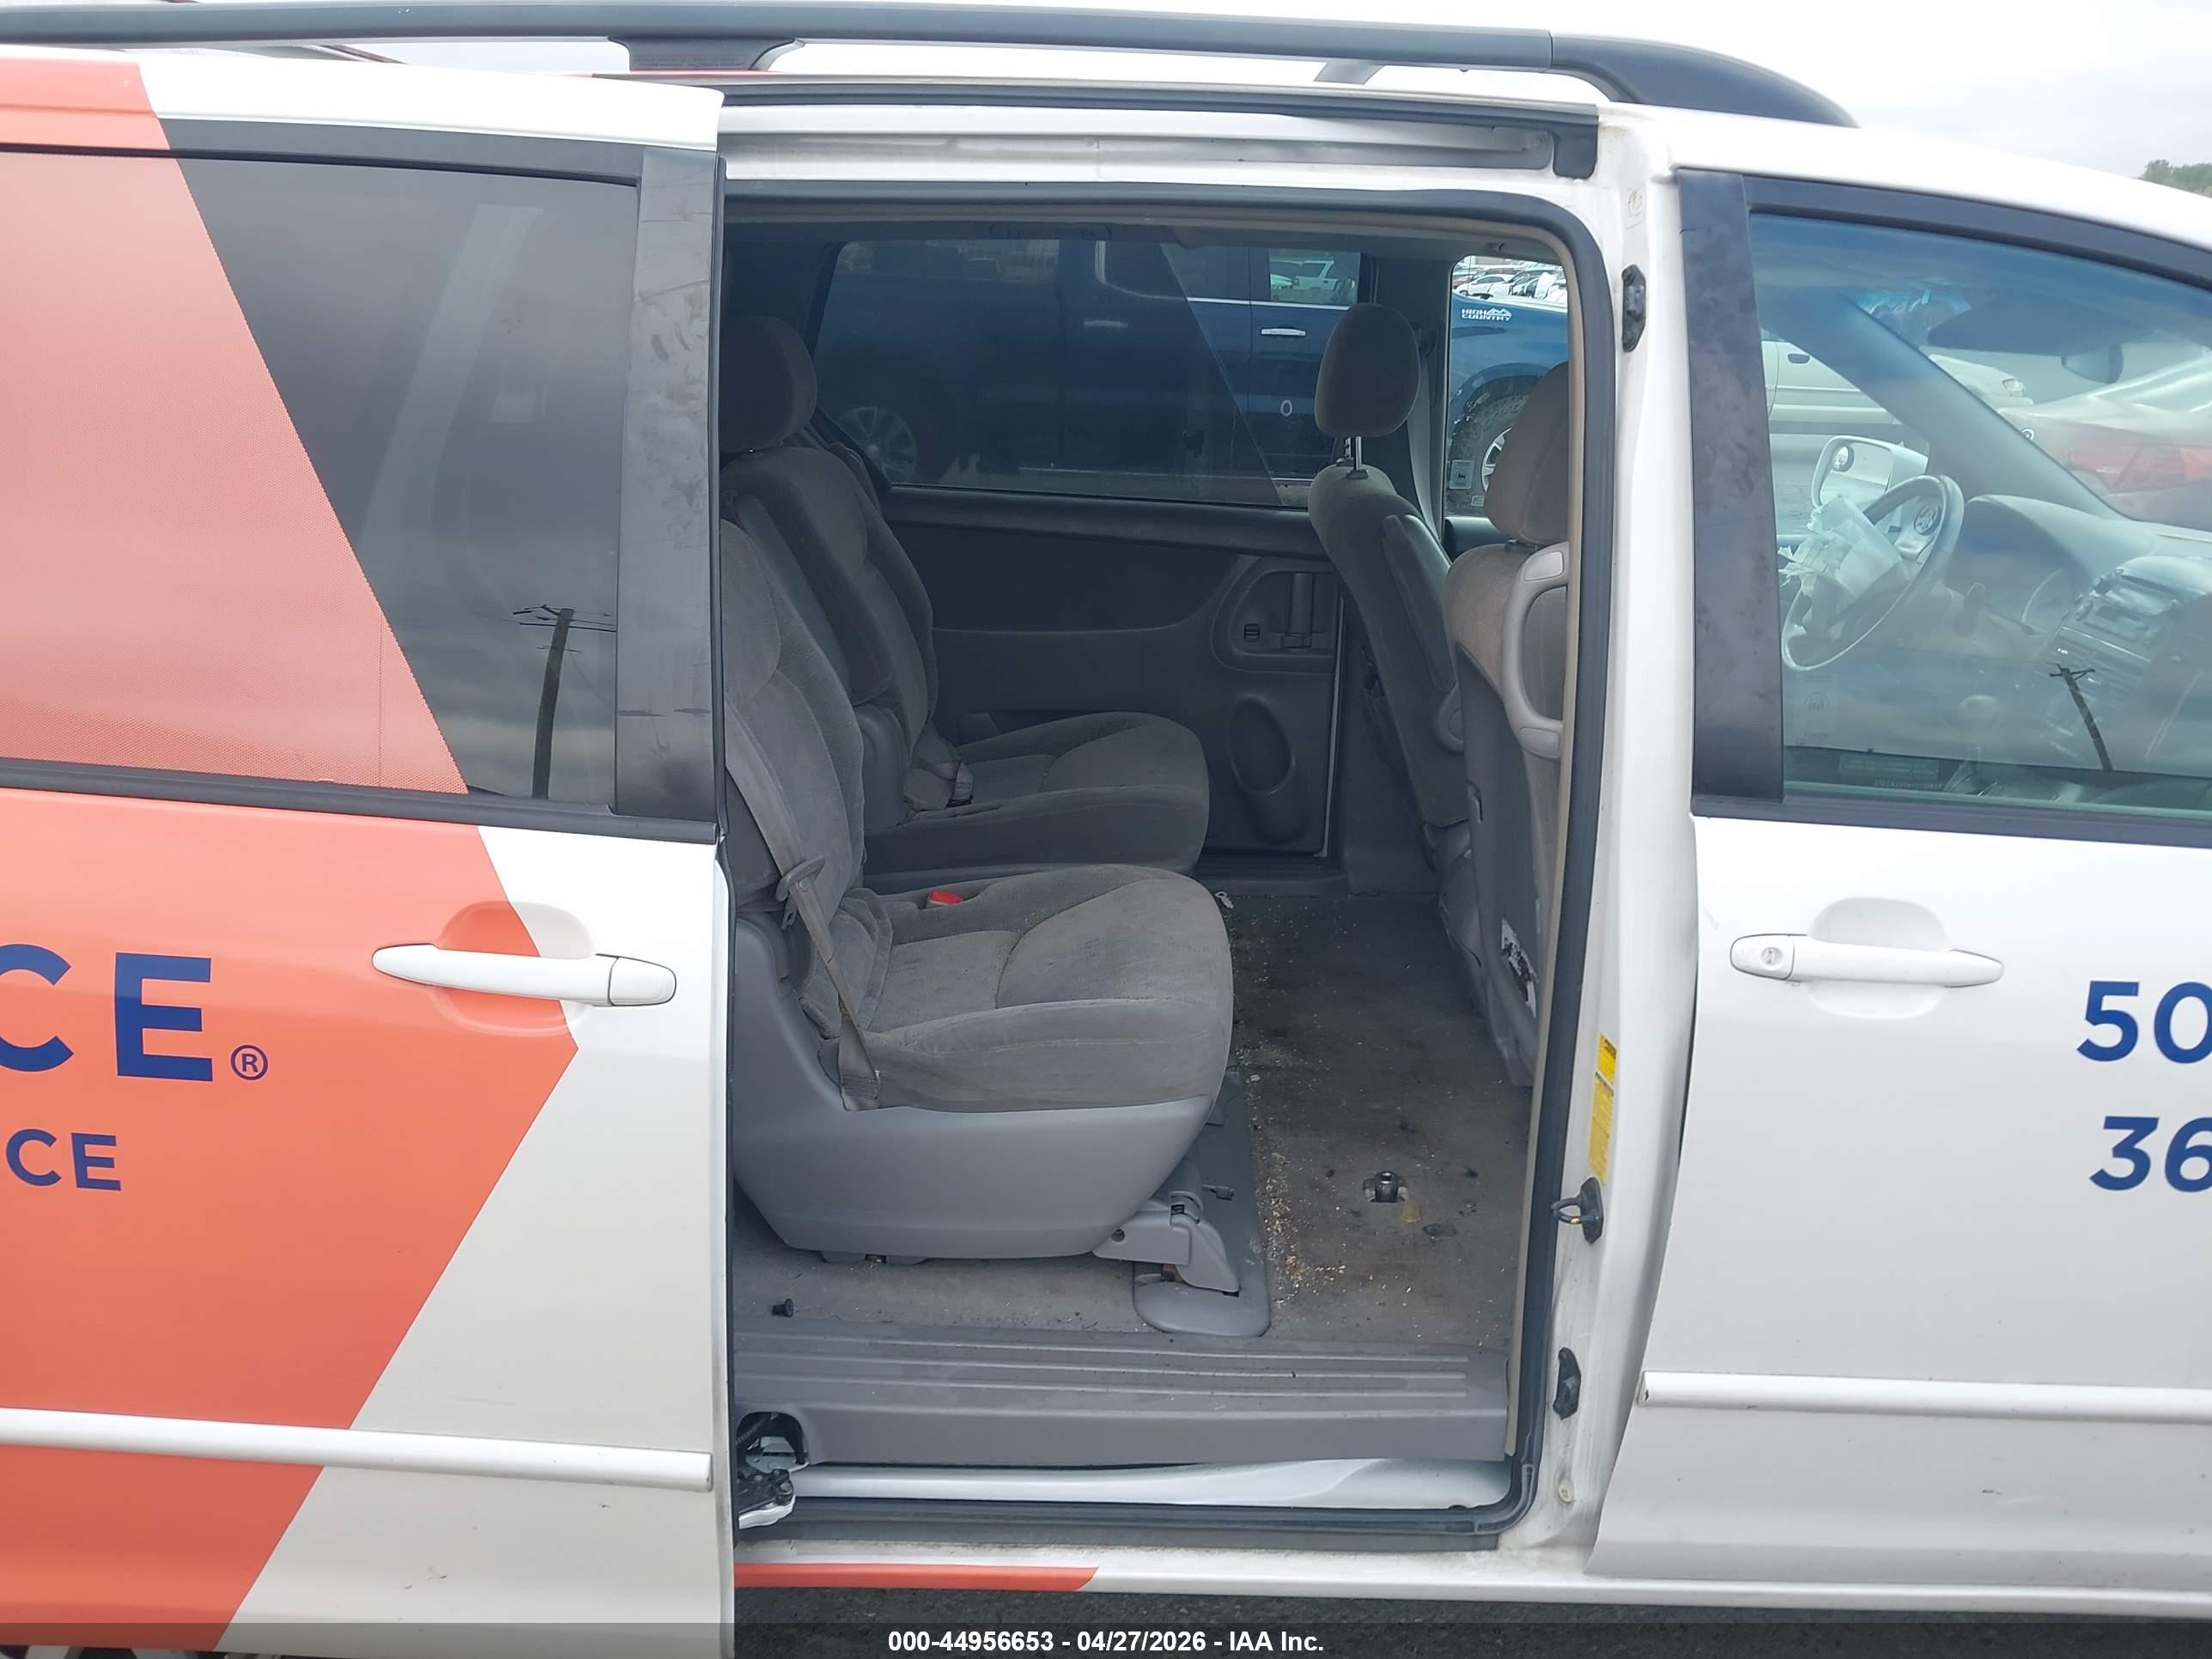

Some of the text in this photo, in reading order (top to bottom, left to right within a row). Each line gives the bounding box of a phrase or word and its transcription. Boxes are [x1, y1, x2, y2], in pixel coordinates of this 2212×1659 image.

[2076, 980, 2212, 1064] 50
[5, 1127, 122, 1191] CE
[2089, 1115, 2212, 1193] 36
